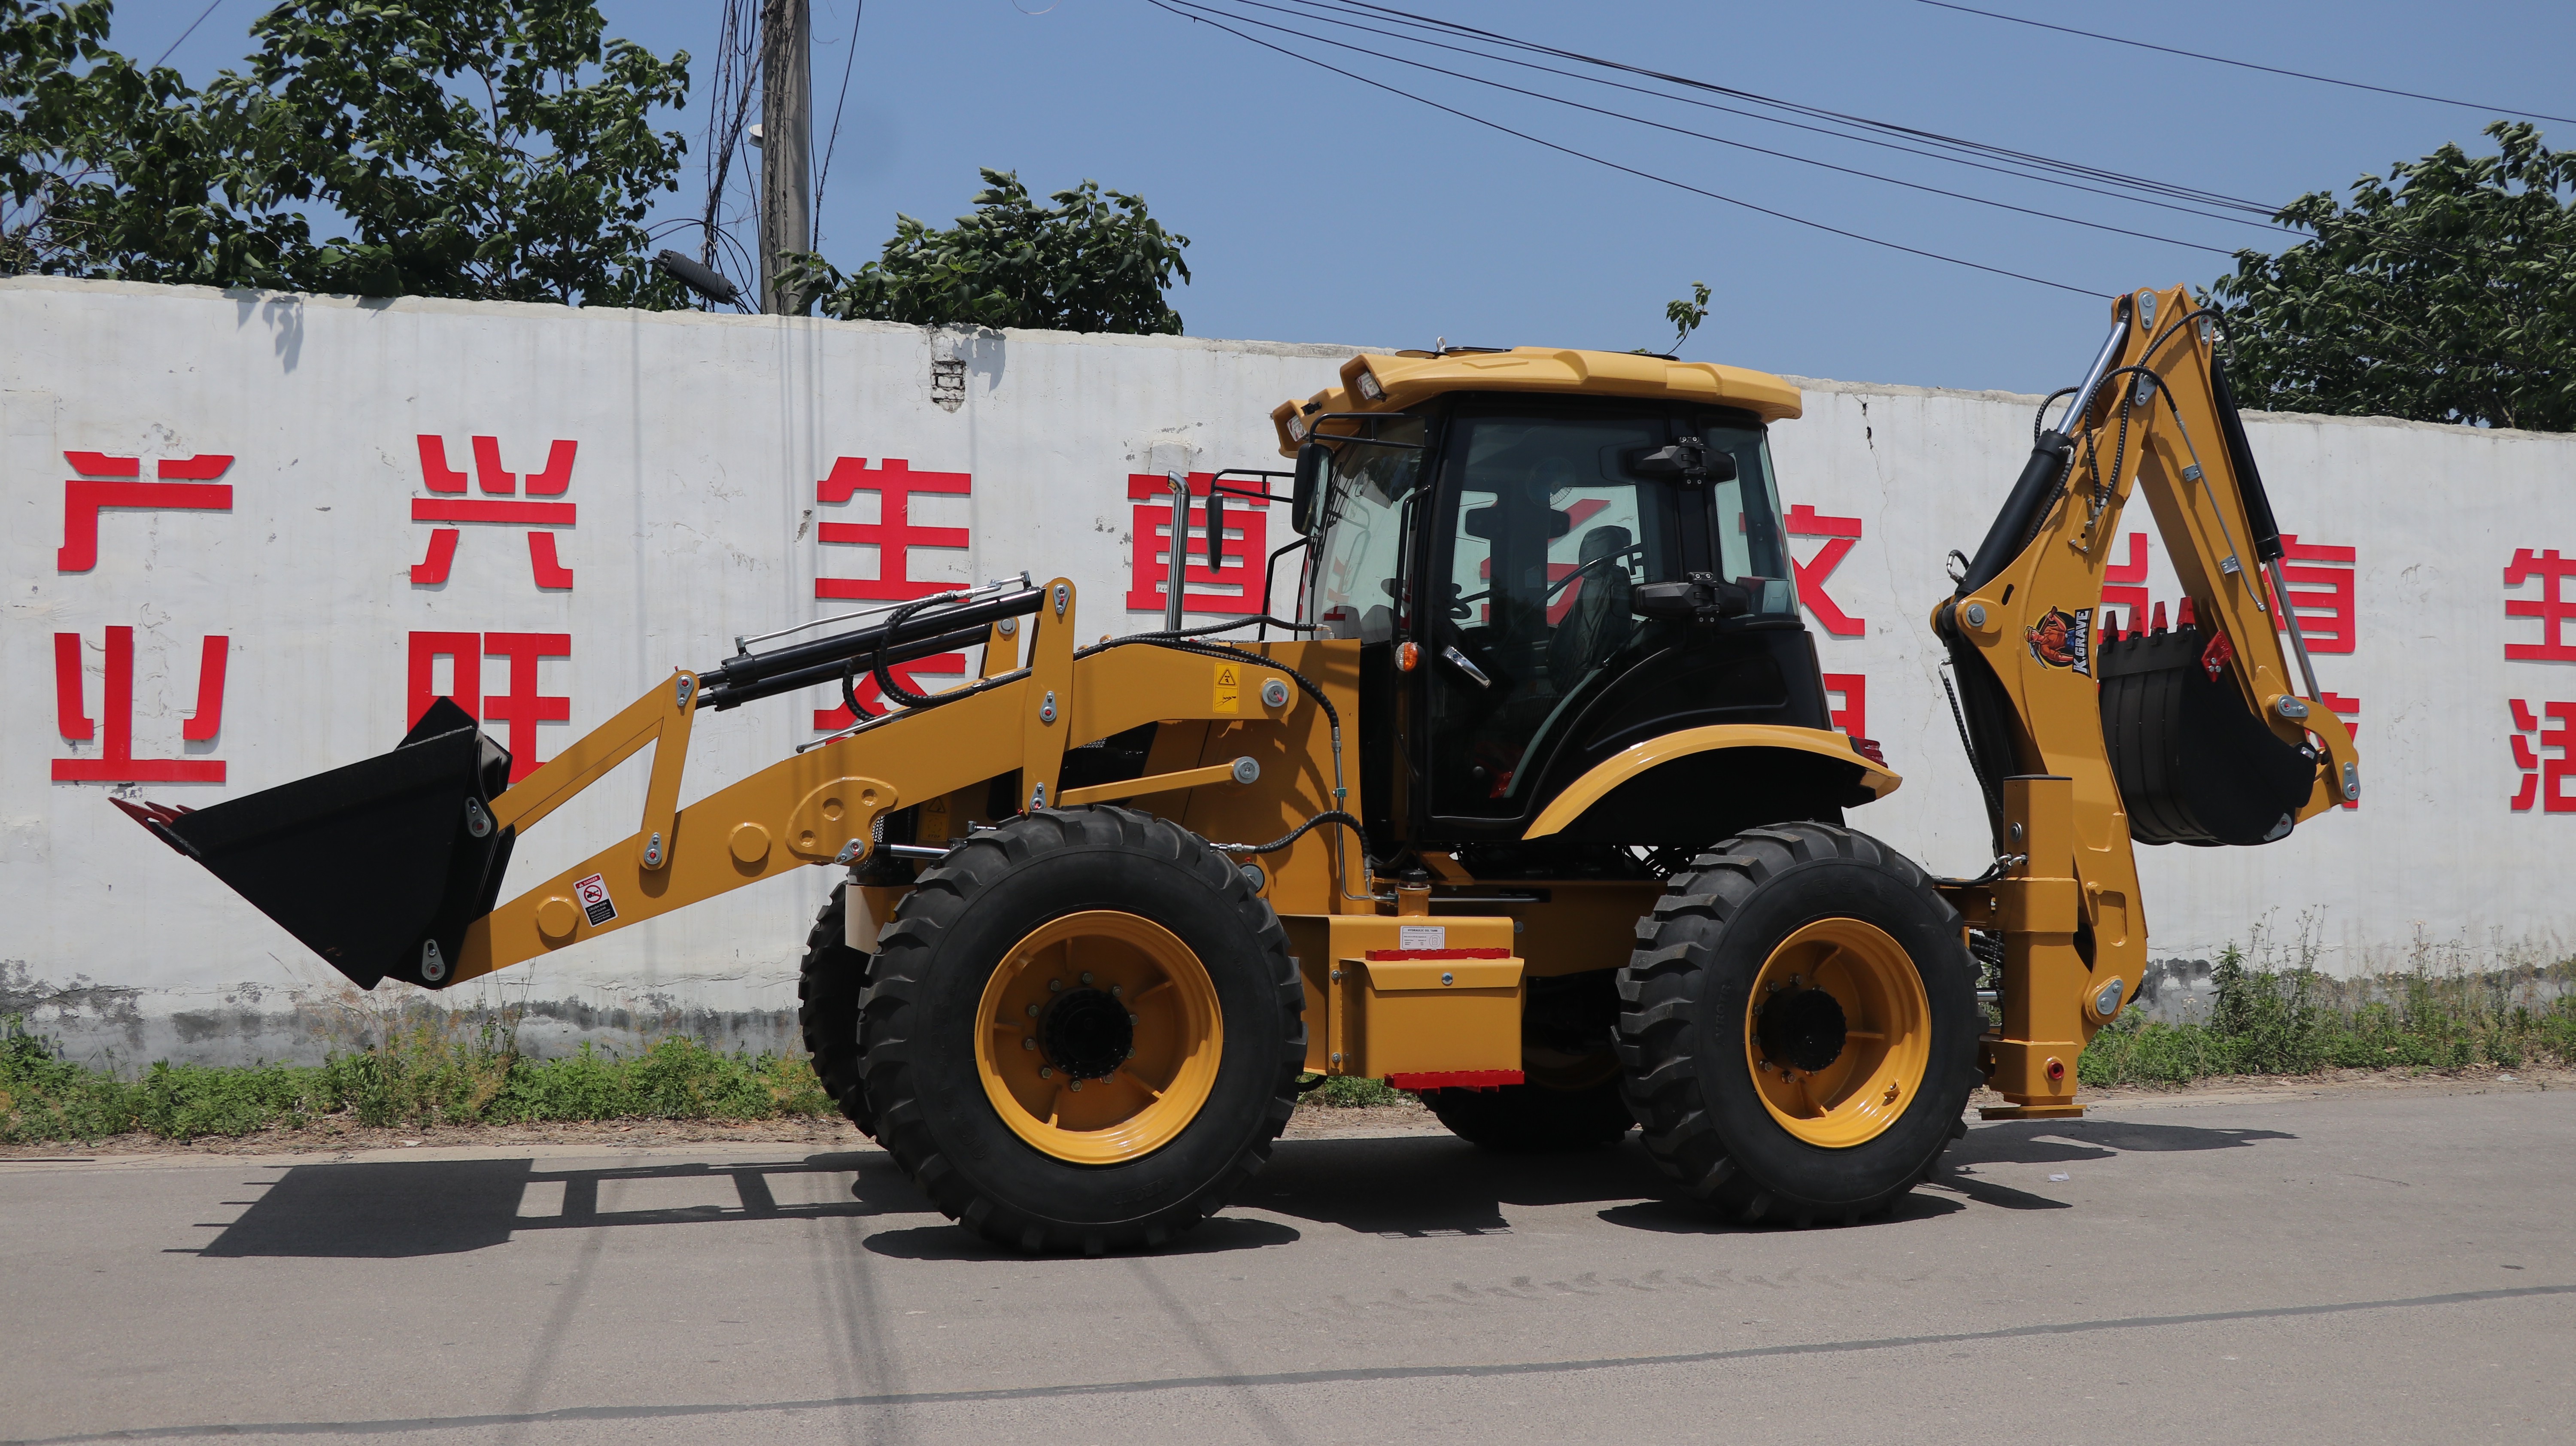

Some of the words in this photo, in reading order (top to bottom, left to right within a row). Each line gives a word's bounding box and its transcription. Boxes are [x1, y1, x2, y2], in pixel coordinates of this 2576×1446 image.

[52, 451, 235, 782] 产业
[408, 434, 577, 784] 兴旺
[2073, 610, 2090, 674] K.GRAVE
[583, 877, 598, 885] DANGER
